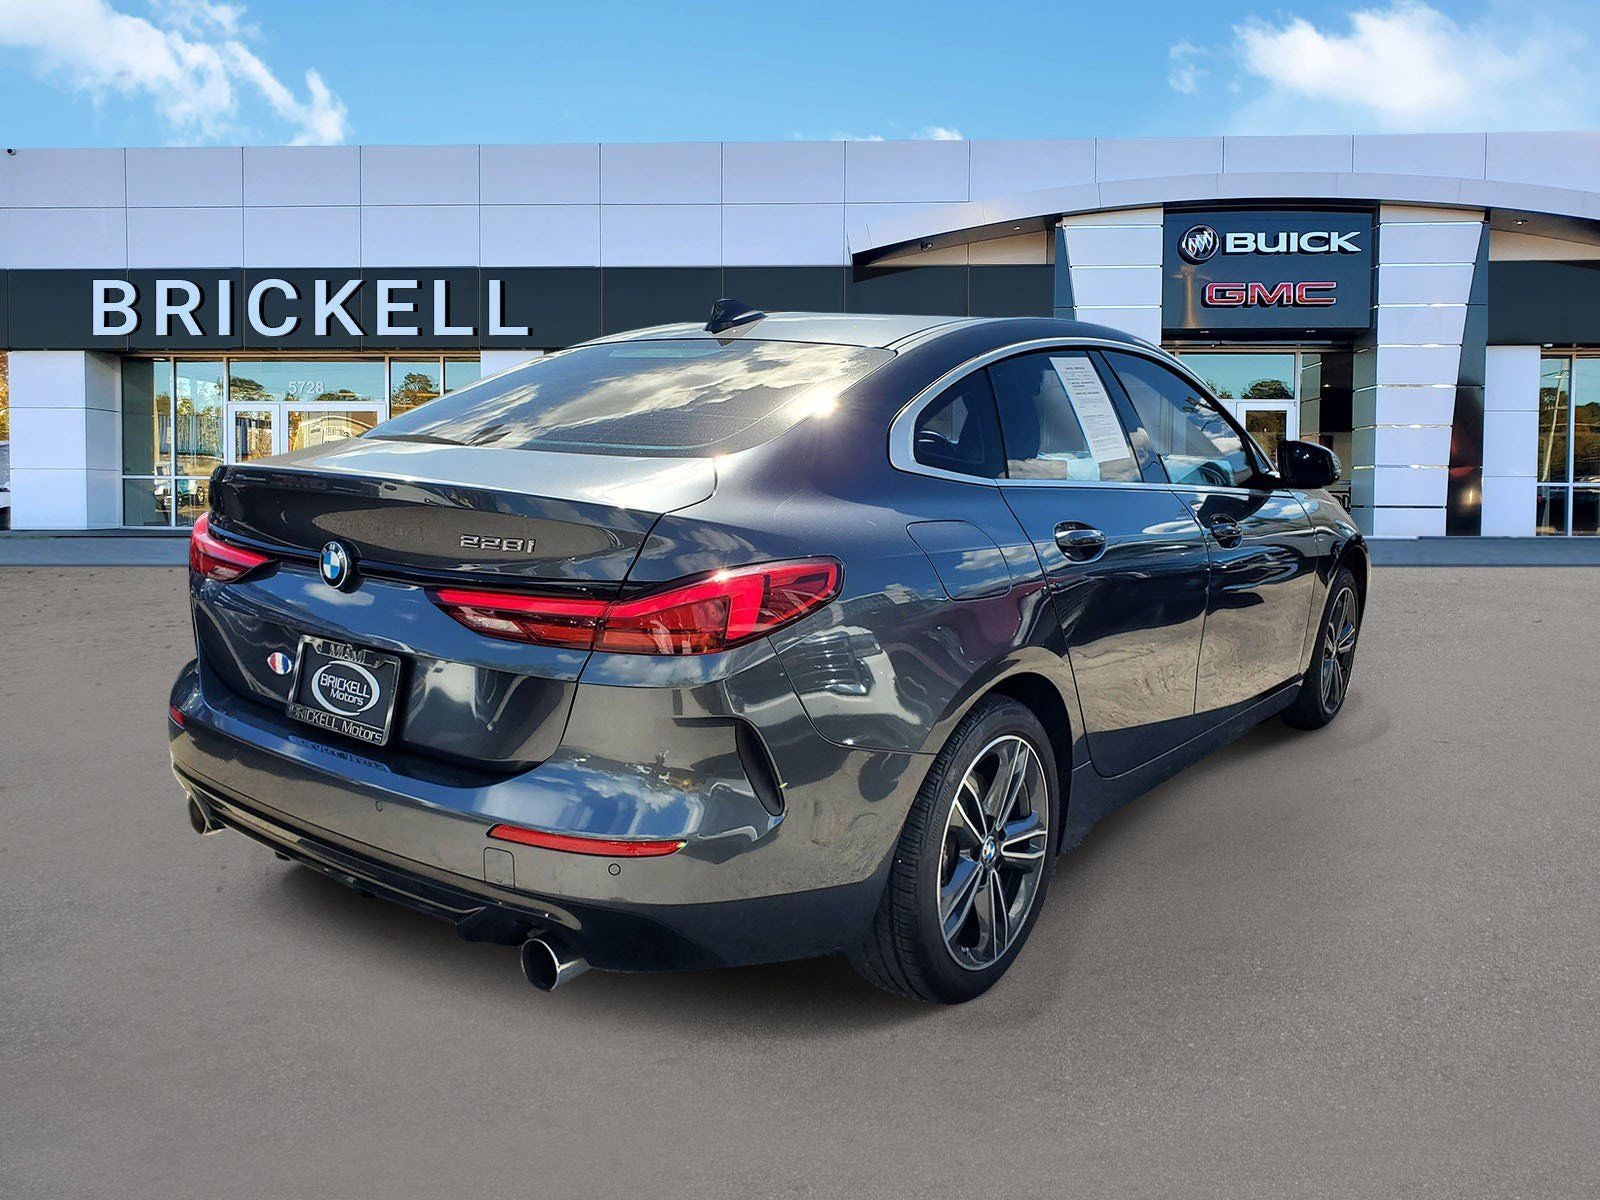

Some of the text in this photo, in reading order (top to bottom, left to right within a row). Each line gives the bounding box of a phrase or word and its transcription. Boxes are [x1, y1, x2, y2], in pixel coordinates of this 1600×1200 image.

[1225, 231, 1362, 253] BUICK
[1204, 281, 1337, 306] GMC
[92, 279, 531, 337] BRICKELL
[287, 381, 325, 394] 5728
[460, 534, 536, 554] 228i
[319, 673, 370, 698] BRICKELL
[329, 689, 364, 706] Motors
[342, 721, 383, 743] Motors
